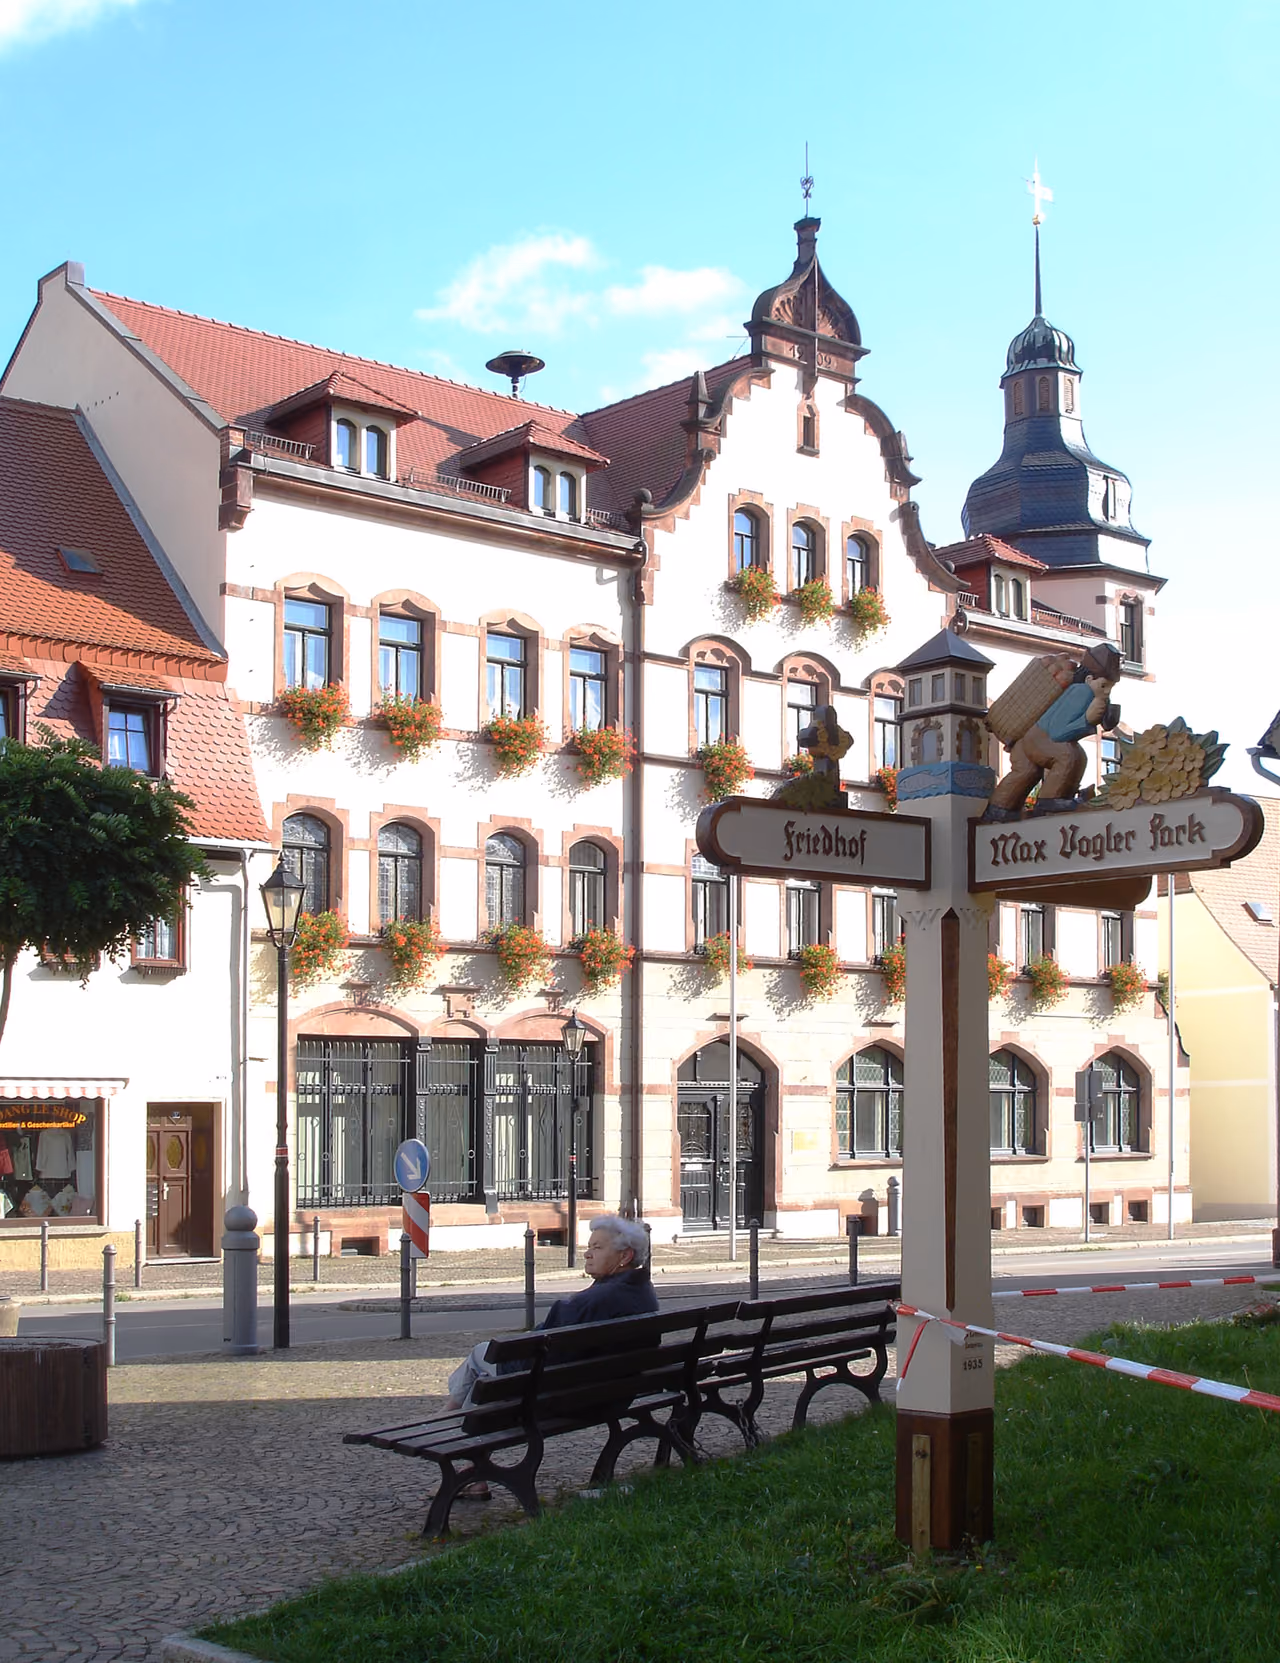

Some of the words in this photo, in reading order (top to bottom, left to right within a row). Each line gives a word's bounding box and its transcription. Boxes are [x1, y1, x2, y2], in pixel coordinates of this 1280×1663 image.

[783, 819, 868, 866] Friedhof
[990, 831, 1048, 867] Max
[1059, 821, 1136, 861] Vogler
[1149, 812, 1206, 851] Park
[53, 1104, 87, 1124] SHOP
[27, 1121, 75, 1129] Geschenkartikel
[962, 1358, 983, 1371] 1935
